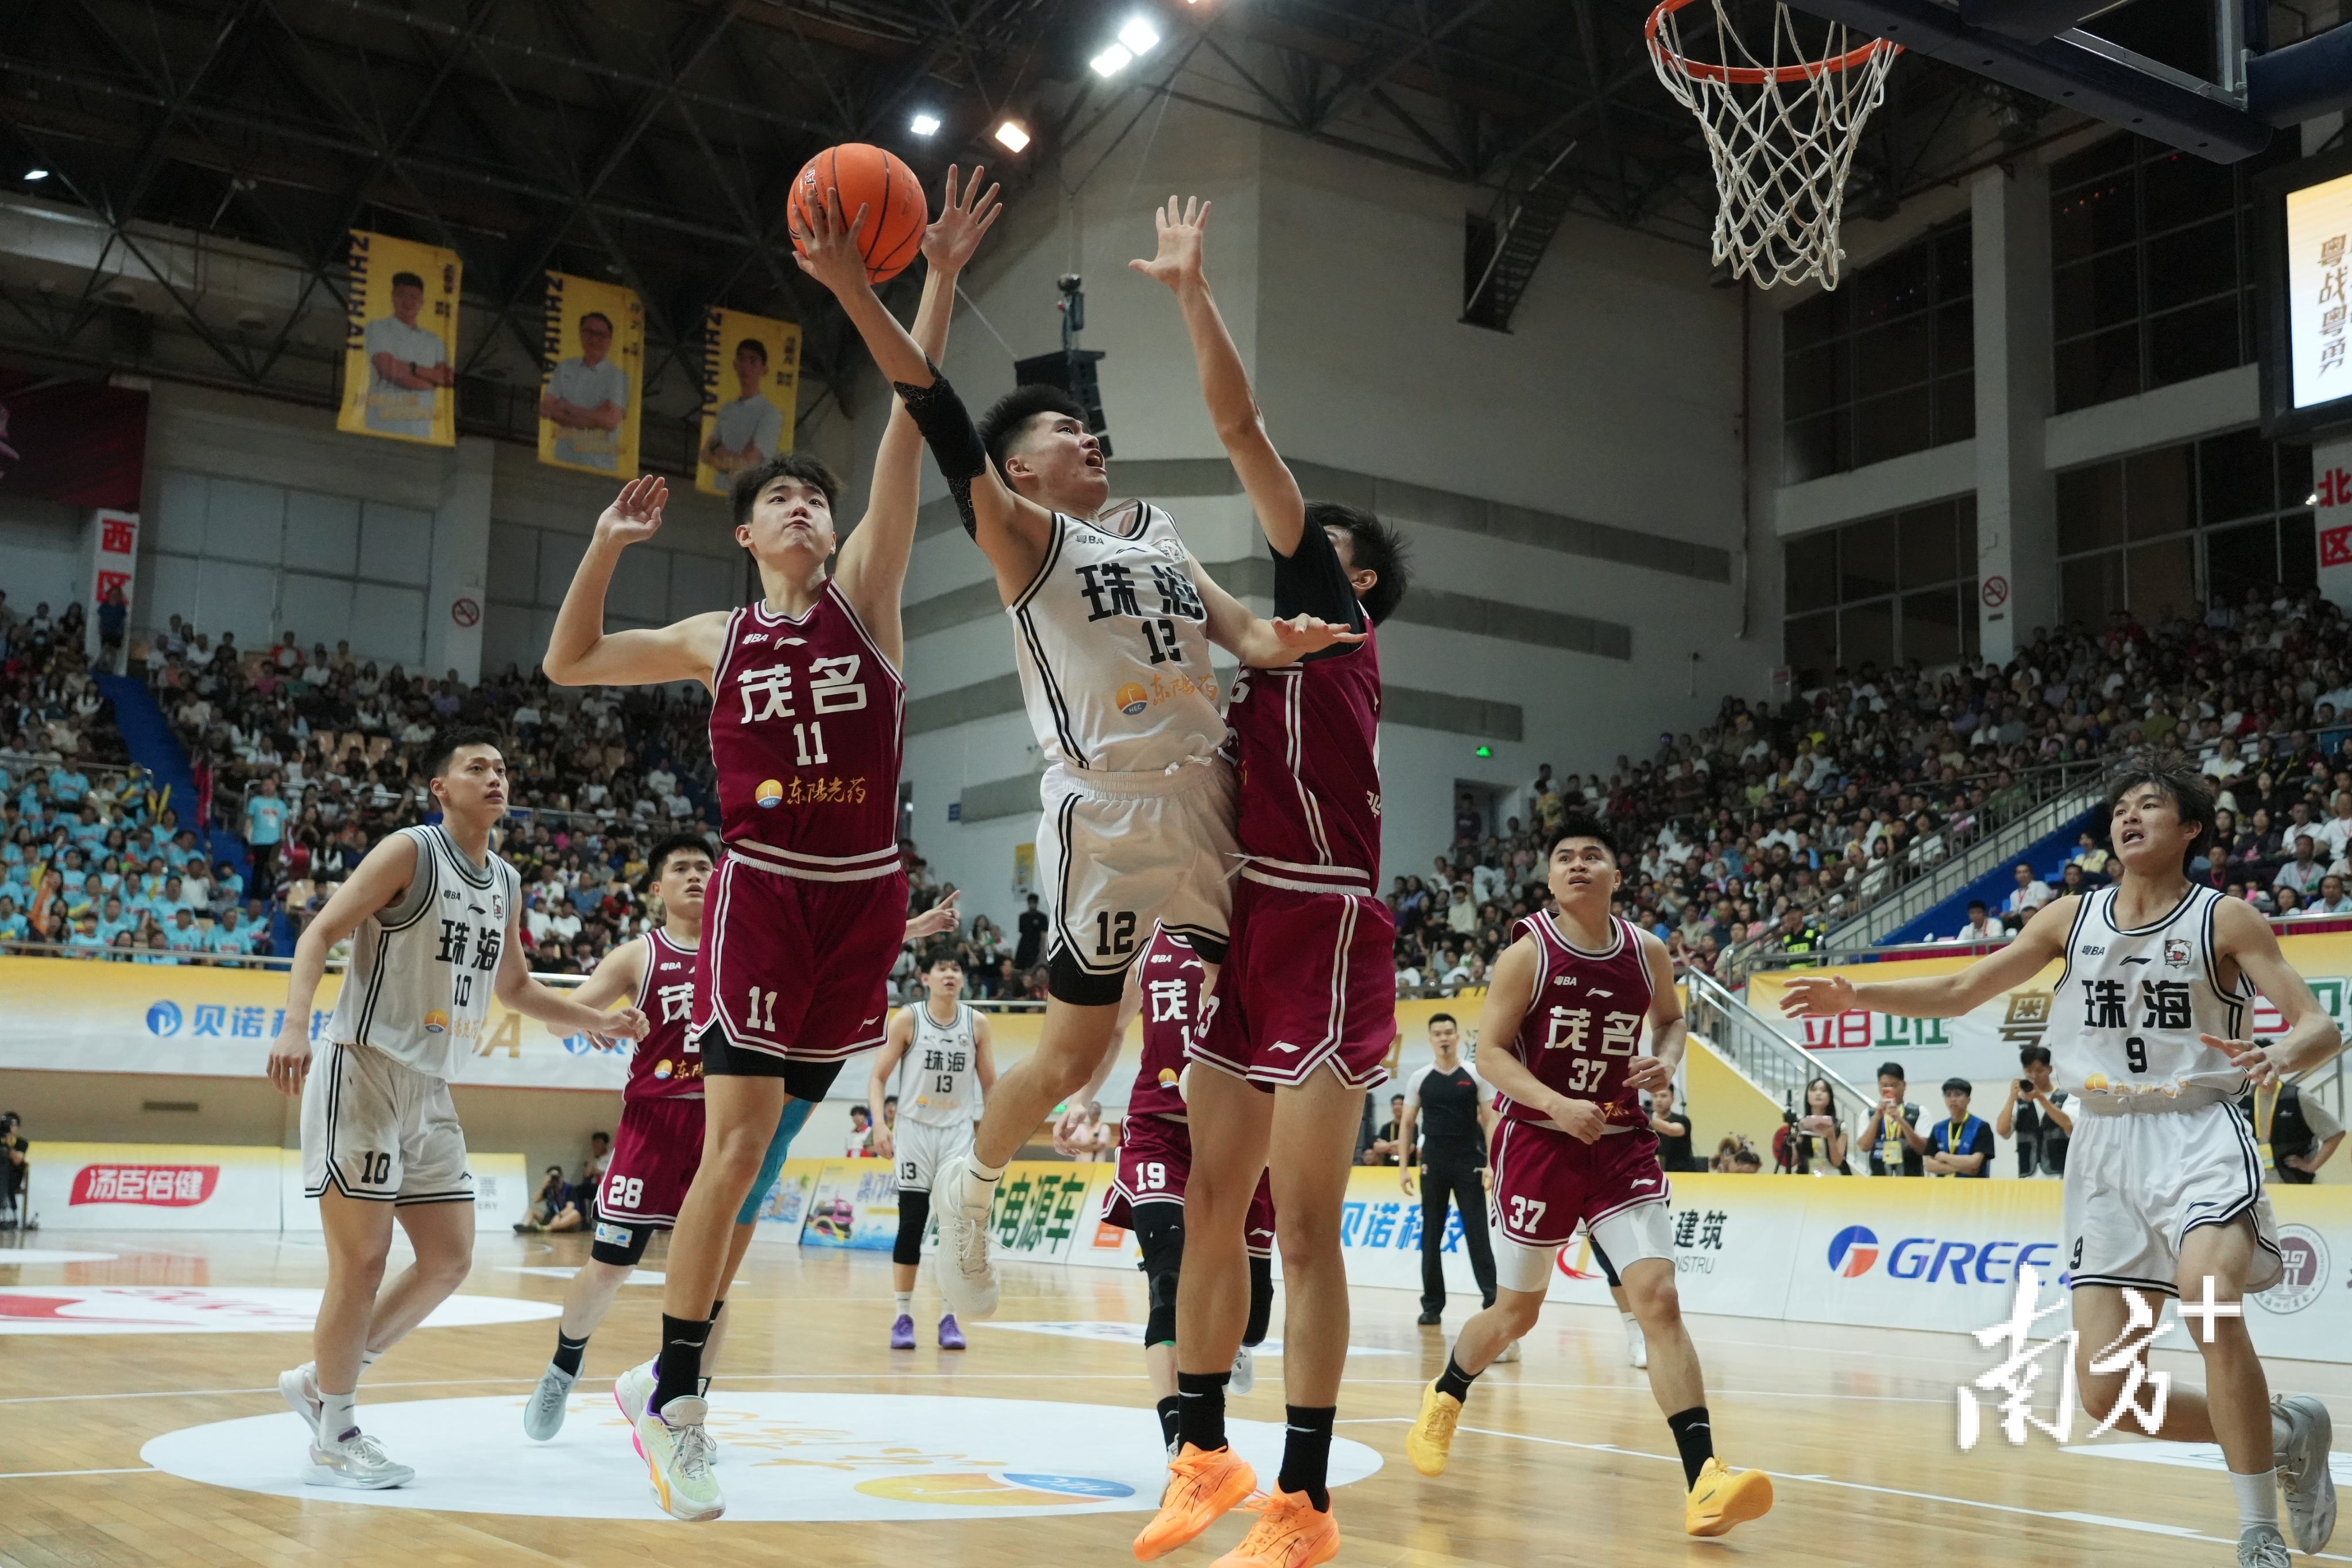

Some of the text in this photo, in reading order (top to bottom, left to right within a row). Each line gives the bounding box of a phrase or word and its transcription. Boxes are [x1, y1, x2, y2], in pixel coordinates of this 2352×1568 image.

[347, 234, 369, 350] ZHUHAI
[2318, 467, 2352, 567] 北区
[1076, 562, 1204, 622] 珠海
[1142, 619, 1182, 664] 12
[737, 655, 867, 724] 茂名
[1128, 704, 1143, 713] HEC
[793, 722, 828, 766] 11
[435, 919, 501, 971] 珠海
[1096, 911, 1136, 955] 12
[2082, 945, 2105, 956] 粤BA
[454, 974, 472, 1007] 10
[746, 986, 777, 1032] 11
[2082, 979, 2192, 1028] 珠海
[1545, 1005, 1641, 1056] 茂名
[924, 1050, 966, 1072] 珠海
[2126, 1037, 2148, 1073] 9
[935, 1075, 953, 1093] 13
[1568, 1058, 1608, 1093] 37
[86, 1168, 204, 1200] 汤臣倍健
[361, 1151, 390, 1184] 10
[900, 1162, 917, 1180] 13
[1135, 1163, 1166, 1190] 19
[608, 1174, 644, 1209] 28
[1509, 1194, 1546, 1233] 37
[1670, 1209, 1727, 1250] 建筑
[1887, 1238, 2059, 1286] GREE
[2069, 1236, 2083, 1269] 9
